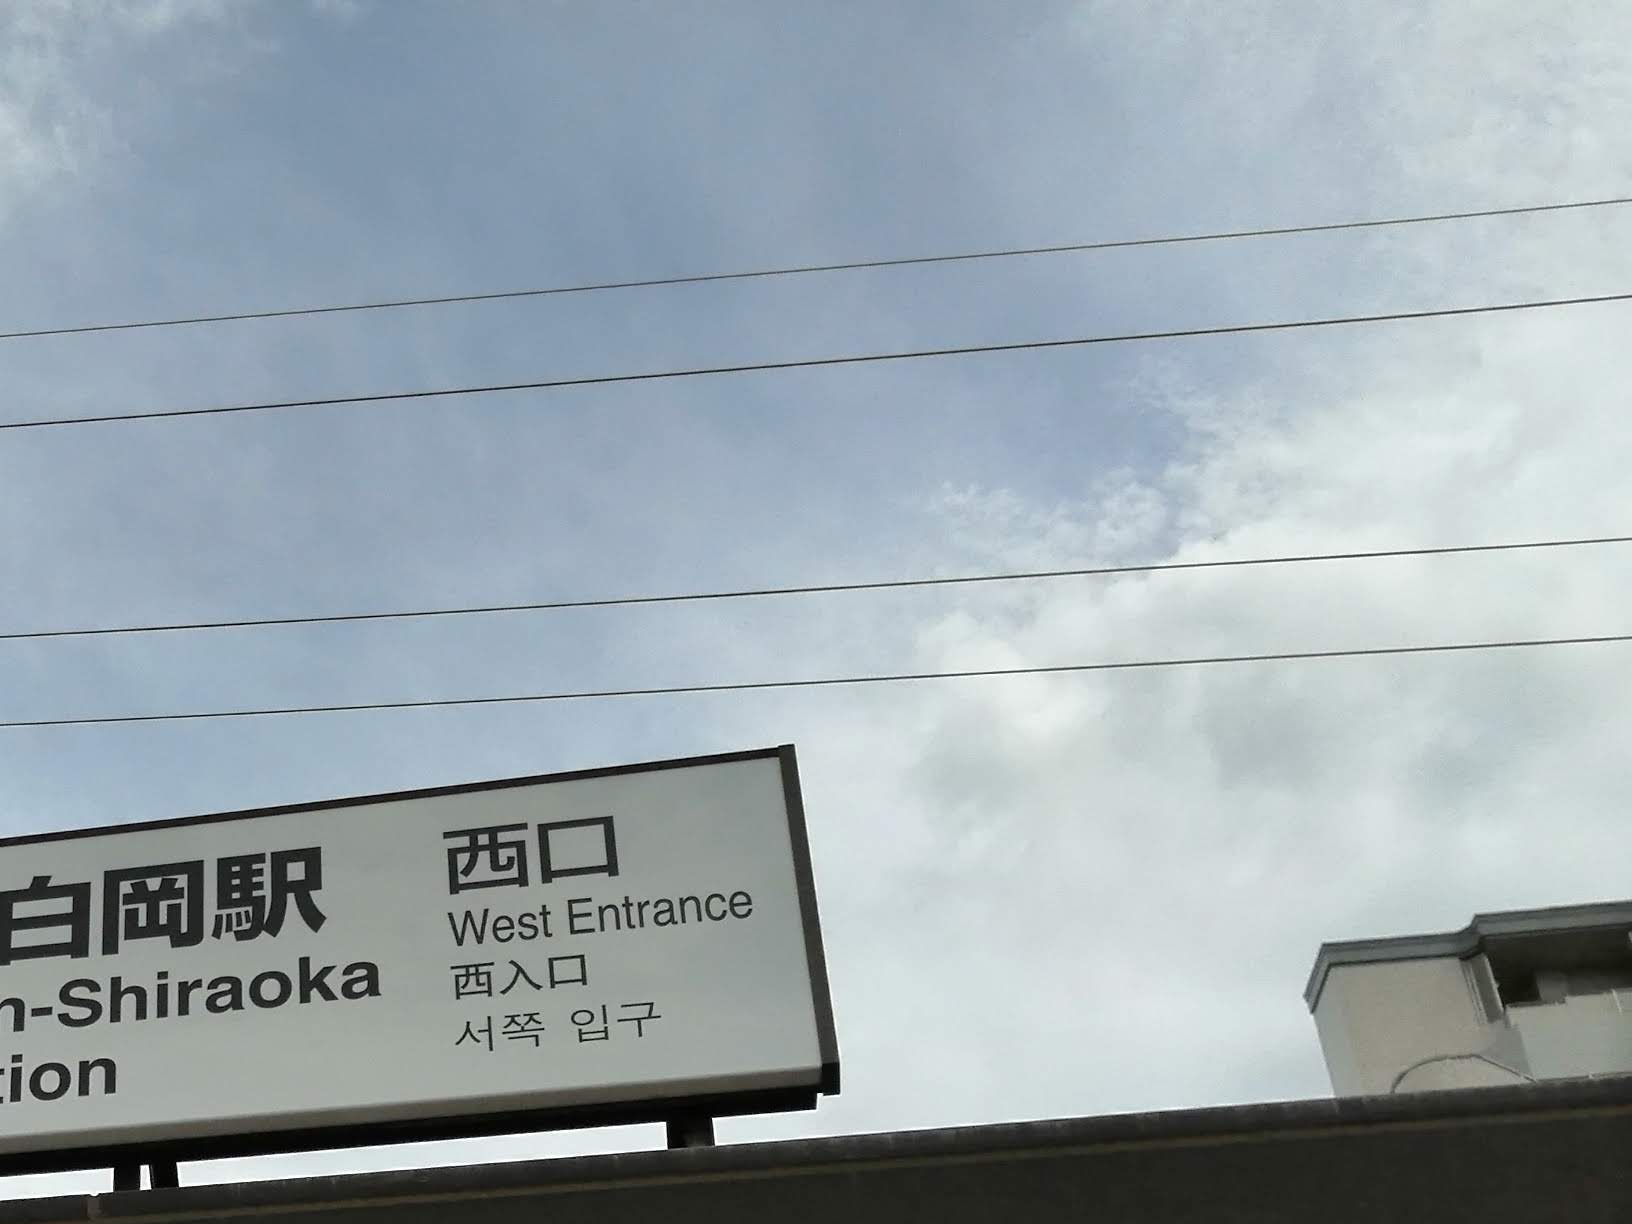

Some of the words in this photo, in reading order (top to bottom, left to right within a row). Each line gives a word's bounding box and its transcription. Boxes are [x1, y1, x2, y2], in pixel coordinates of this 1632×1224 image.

[442, 815, 620, 895] 西口
[447, 903, 554, 947] West
[566, 890, 753, 936] Entrance
[449, 953, 588, 1001] 西入口
[454, 1011, 546, 1052] 서쪽
[570, 1001, 663, 1044] 입구
